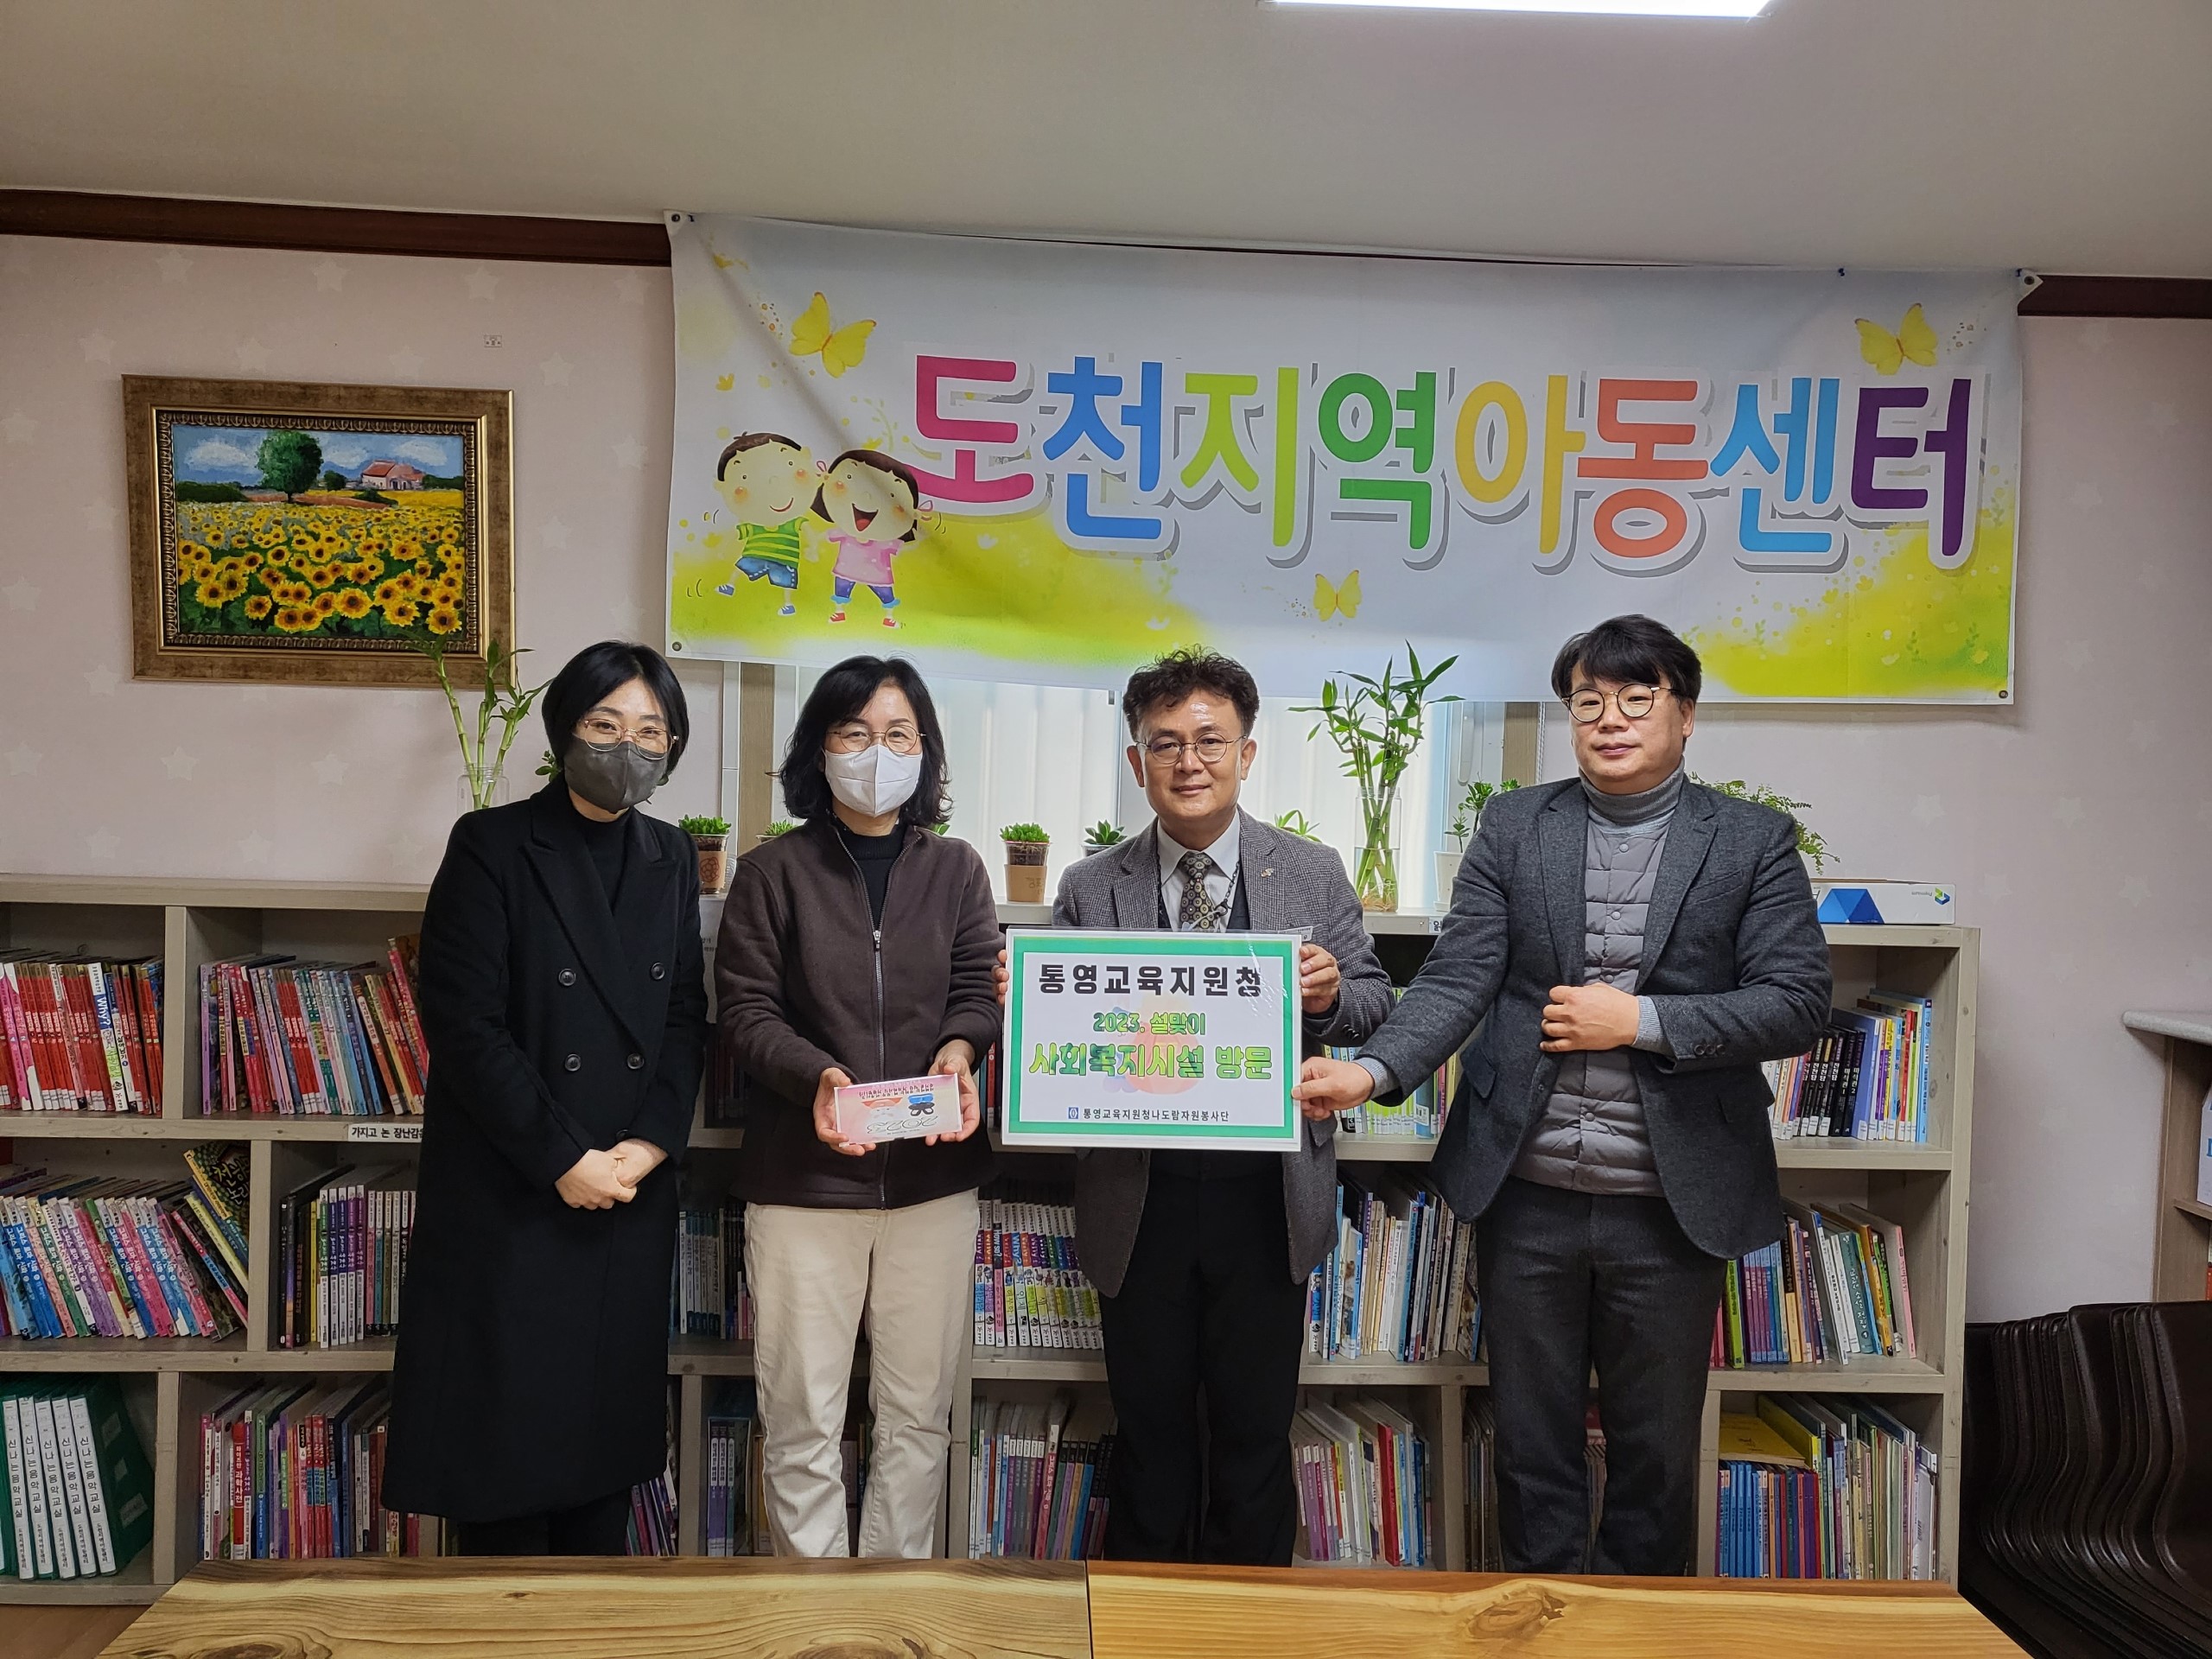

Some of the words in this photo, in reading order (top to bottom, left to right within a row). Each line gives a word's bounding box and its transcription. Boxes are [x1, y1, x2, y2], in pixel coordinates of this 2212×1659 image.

[909, 353, 1975, 560] 도천지역아동센터
[1039, 963, 1262, 997] 통영교육지원청
[97, 995, 111, 1026] Why?
[1093, 1012, 1145, 1033] 2023.
[1150, 1012, 1206, 1035] 설맞이
[1029, 1042, 1205, 1078] 사회복지시설
[1215, 1046, 1272, 1079] 방문
[352, 1127, 378, 1138] 가지고
[867, 1116, 938, 1134] 2023
[1012, 1233, 1022, 1267] Why?
[79, 1436, 101, 1514] 신나는음악교실
